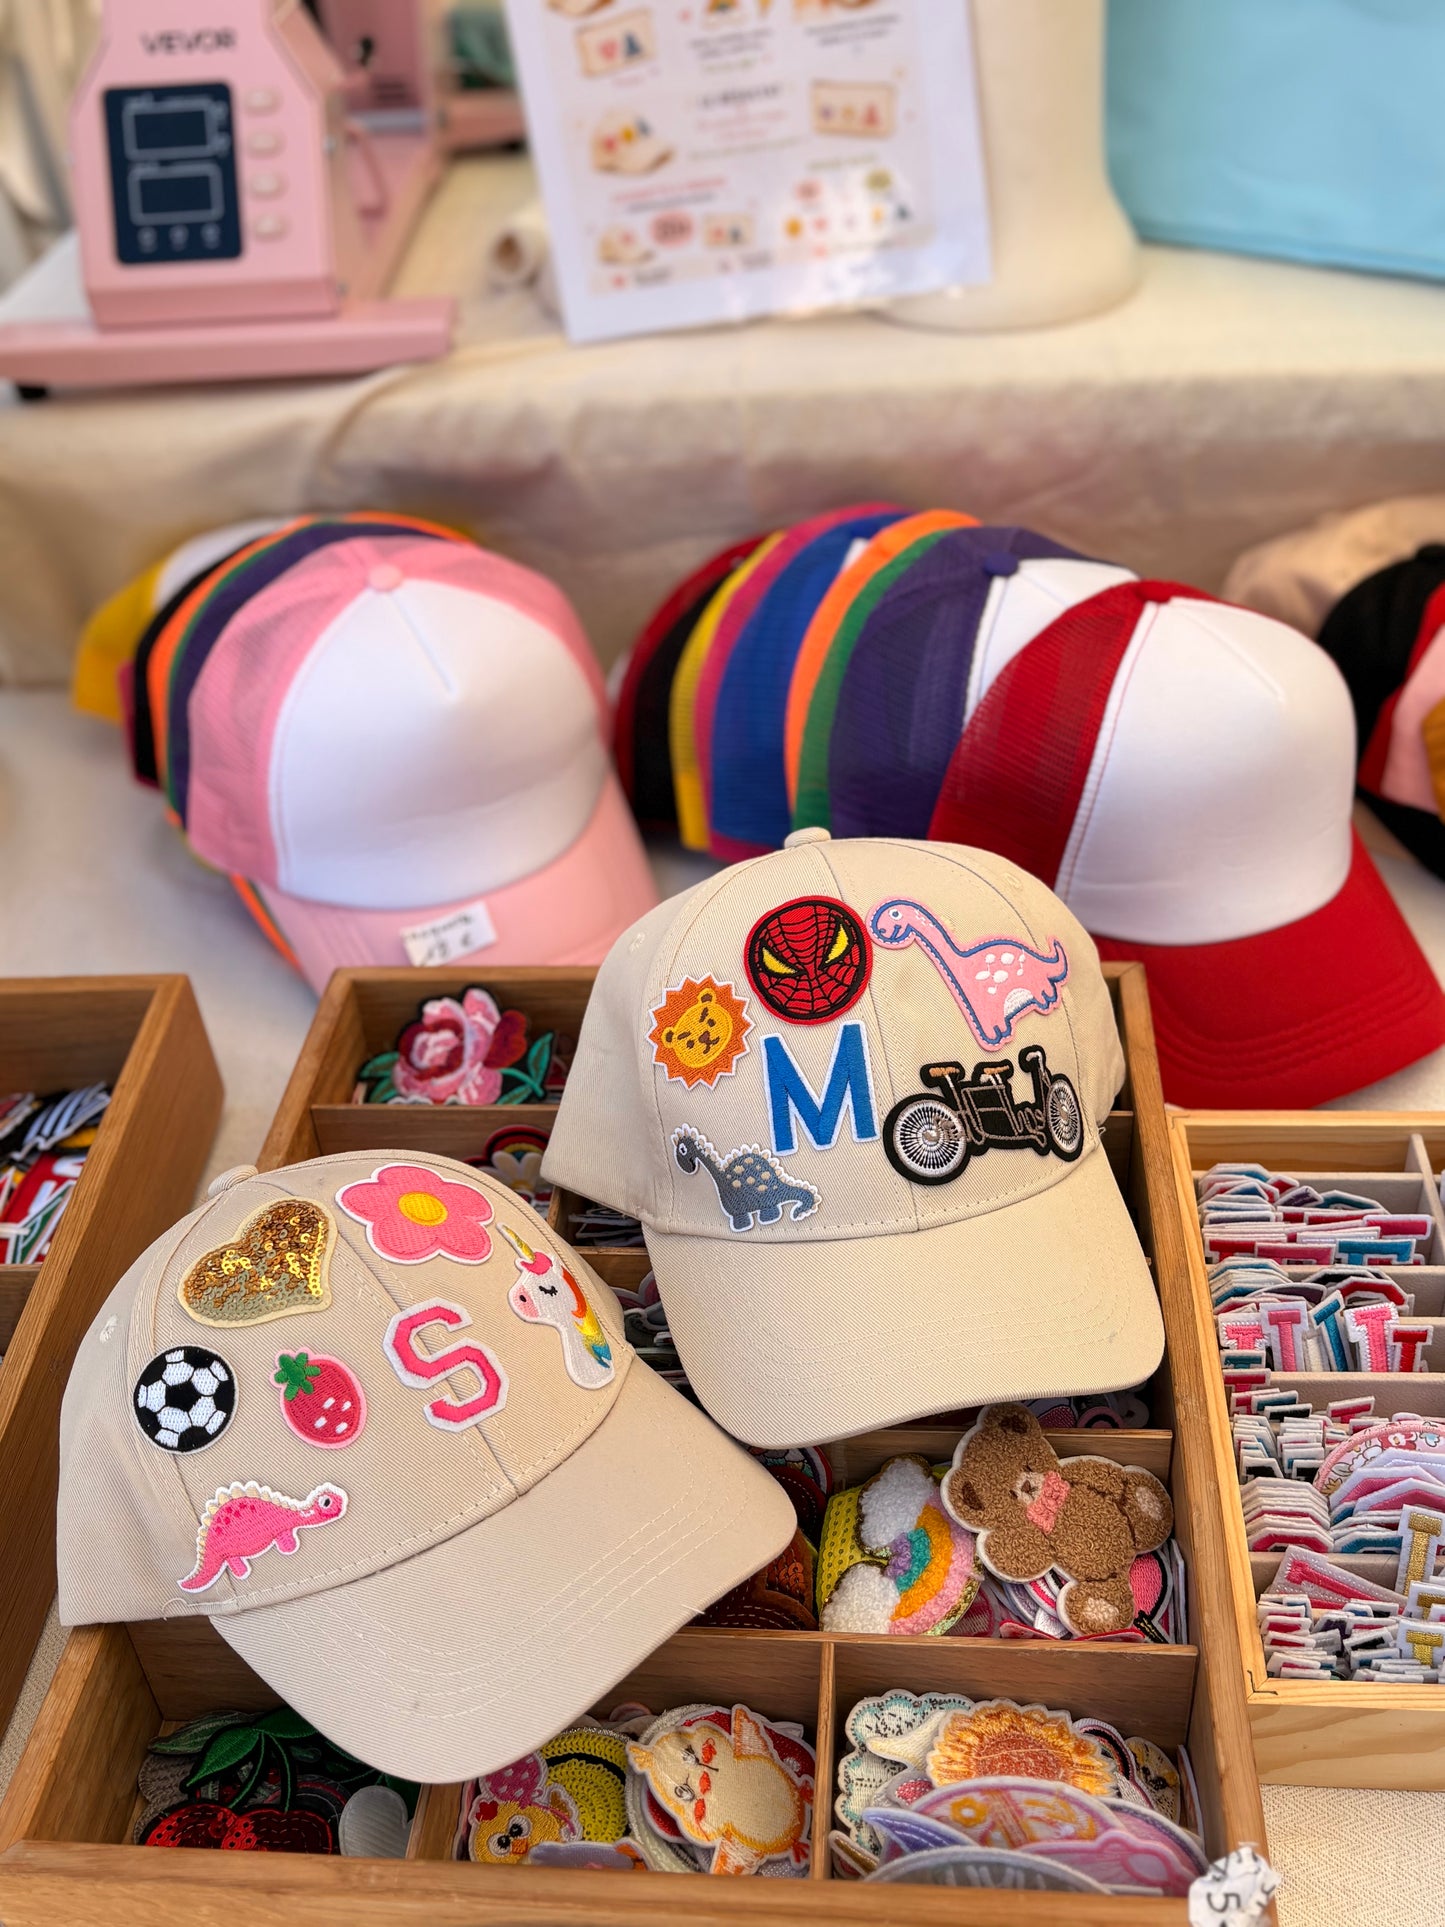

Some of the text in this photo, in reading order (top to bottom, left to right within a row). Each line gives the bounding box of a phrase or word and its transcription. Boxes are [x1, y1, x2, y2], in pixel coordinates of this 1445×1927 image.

[139, 27, 237, 56] VEVOR
[762, 1022, 879, 1153] M
[390, 1304, 504, 1425] S
